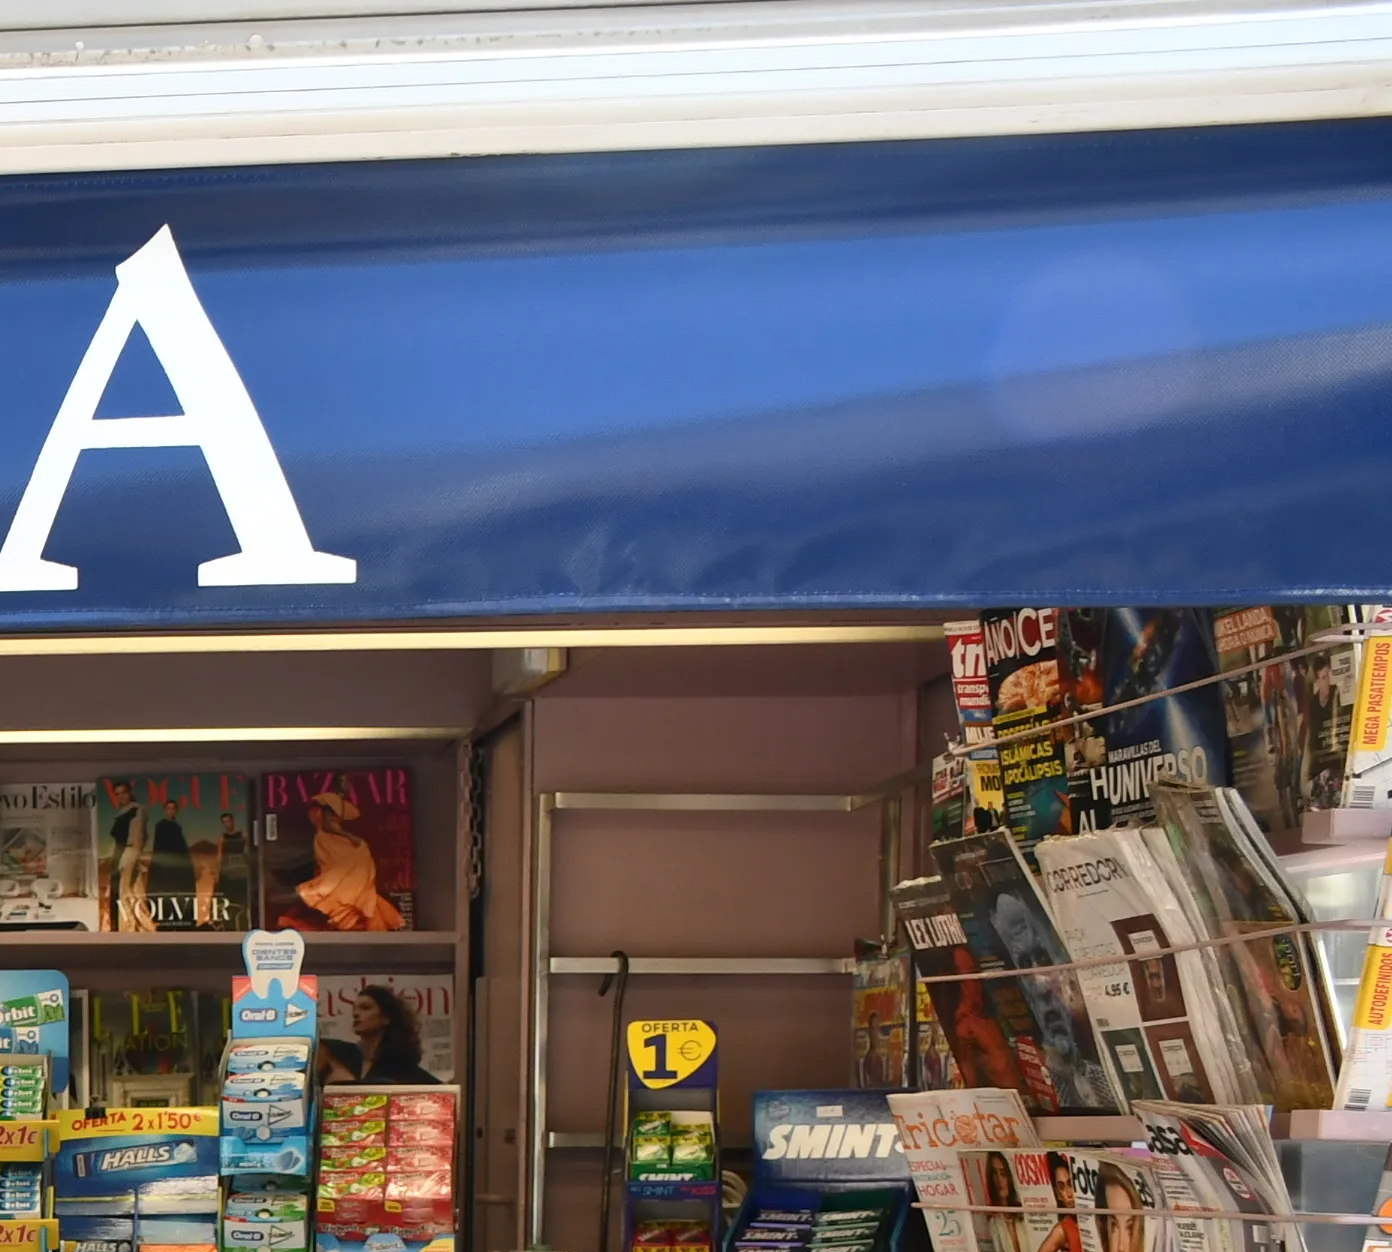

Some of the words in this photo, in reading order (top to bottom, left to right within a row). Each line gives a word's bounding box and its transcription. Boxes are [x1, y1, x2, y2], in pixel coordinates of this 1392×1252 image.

[1368, 642, 1391, 715] PASATIEMPOS
[1363, 714, 1380, 746] MEGA
[1004, 760, 1064, 786] APOCALIPSIS
[1367, 951, 1392, 1026] AUTODEFINIDOS
[241, 1009, 277, 1021] Oral-B
[641, 1022, 699, 1034] OFERTA
[71, 1112, 127, 1132] OFERTA
[893, 1102, 1022, 1151] Tricotar
[761, 1123, 900, 1160] SMINT
[100, 1145, 171, 1170] HALLS
[642, 1186, 675, 1196] SMINT
[918, 1182, 959, 1197] HOGAR
